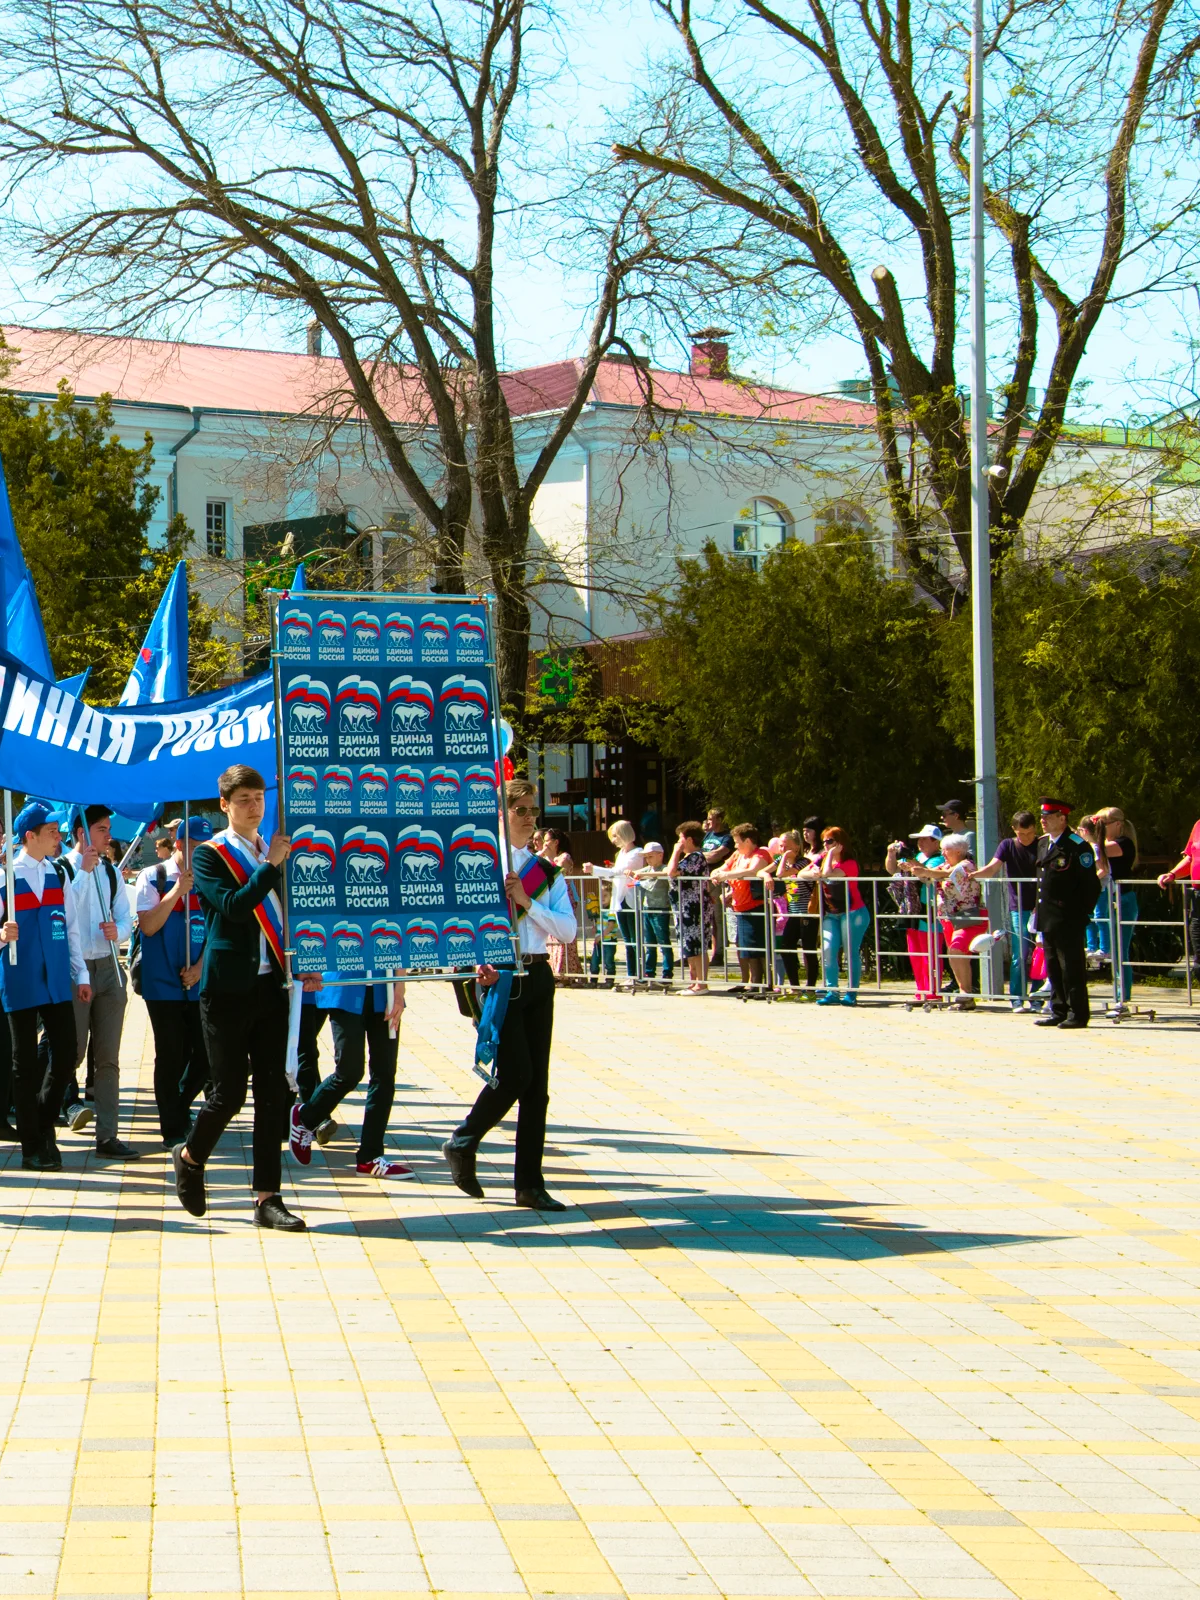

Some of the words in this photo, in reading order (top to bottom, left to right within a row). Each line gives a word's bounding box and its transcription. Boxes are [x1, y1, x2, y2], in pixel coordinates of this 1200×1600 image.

[149, 701, 276, 761] РОССИ
[289, 735, 328, 745] ЕДИНАЯ
[339, 735, 379, 745] ЕДИНАЯ
[391, 734, 432, 745] ЕДИНАЯ
[444, 733, 487, 744] ЕДИНАЯ
[289, 746, 329, 757] РОССИЯ
[340, 746, 380, 757] РОССИЯ
[392, 746, 433, 756] РОССИЯ
[446, 744, 488, 755] РОССИЯ
[292, 885, 334, 896] ЕДИНАЯ
[345, 886, 388, 896] ЕДИНАЯ
[401, 884, 443, 895] ЕДИНАЯ
[455, 882, 498, 893] ЕДИНАЯ
[293, 896, 336, 908] РОССИЯ
[347, 897, 389, 908] РОССИЯ
[402, 895, 444, 906] РОССИЯ
[457, 893, 500, 904] РОССИЯ
[410, 953, 438, 961] ЕДИНАЯ
[447, 952, 476, 960] ЕДИНАЯ
[484, 949, 511, 957] ЕДИНАЯ
[374, 955, 401, 963] ЕДИНАЯ
[485, 955, 513, 963] РОССИЯ
